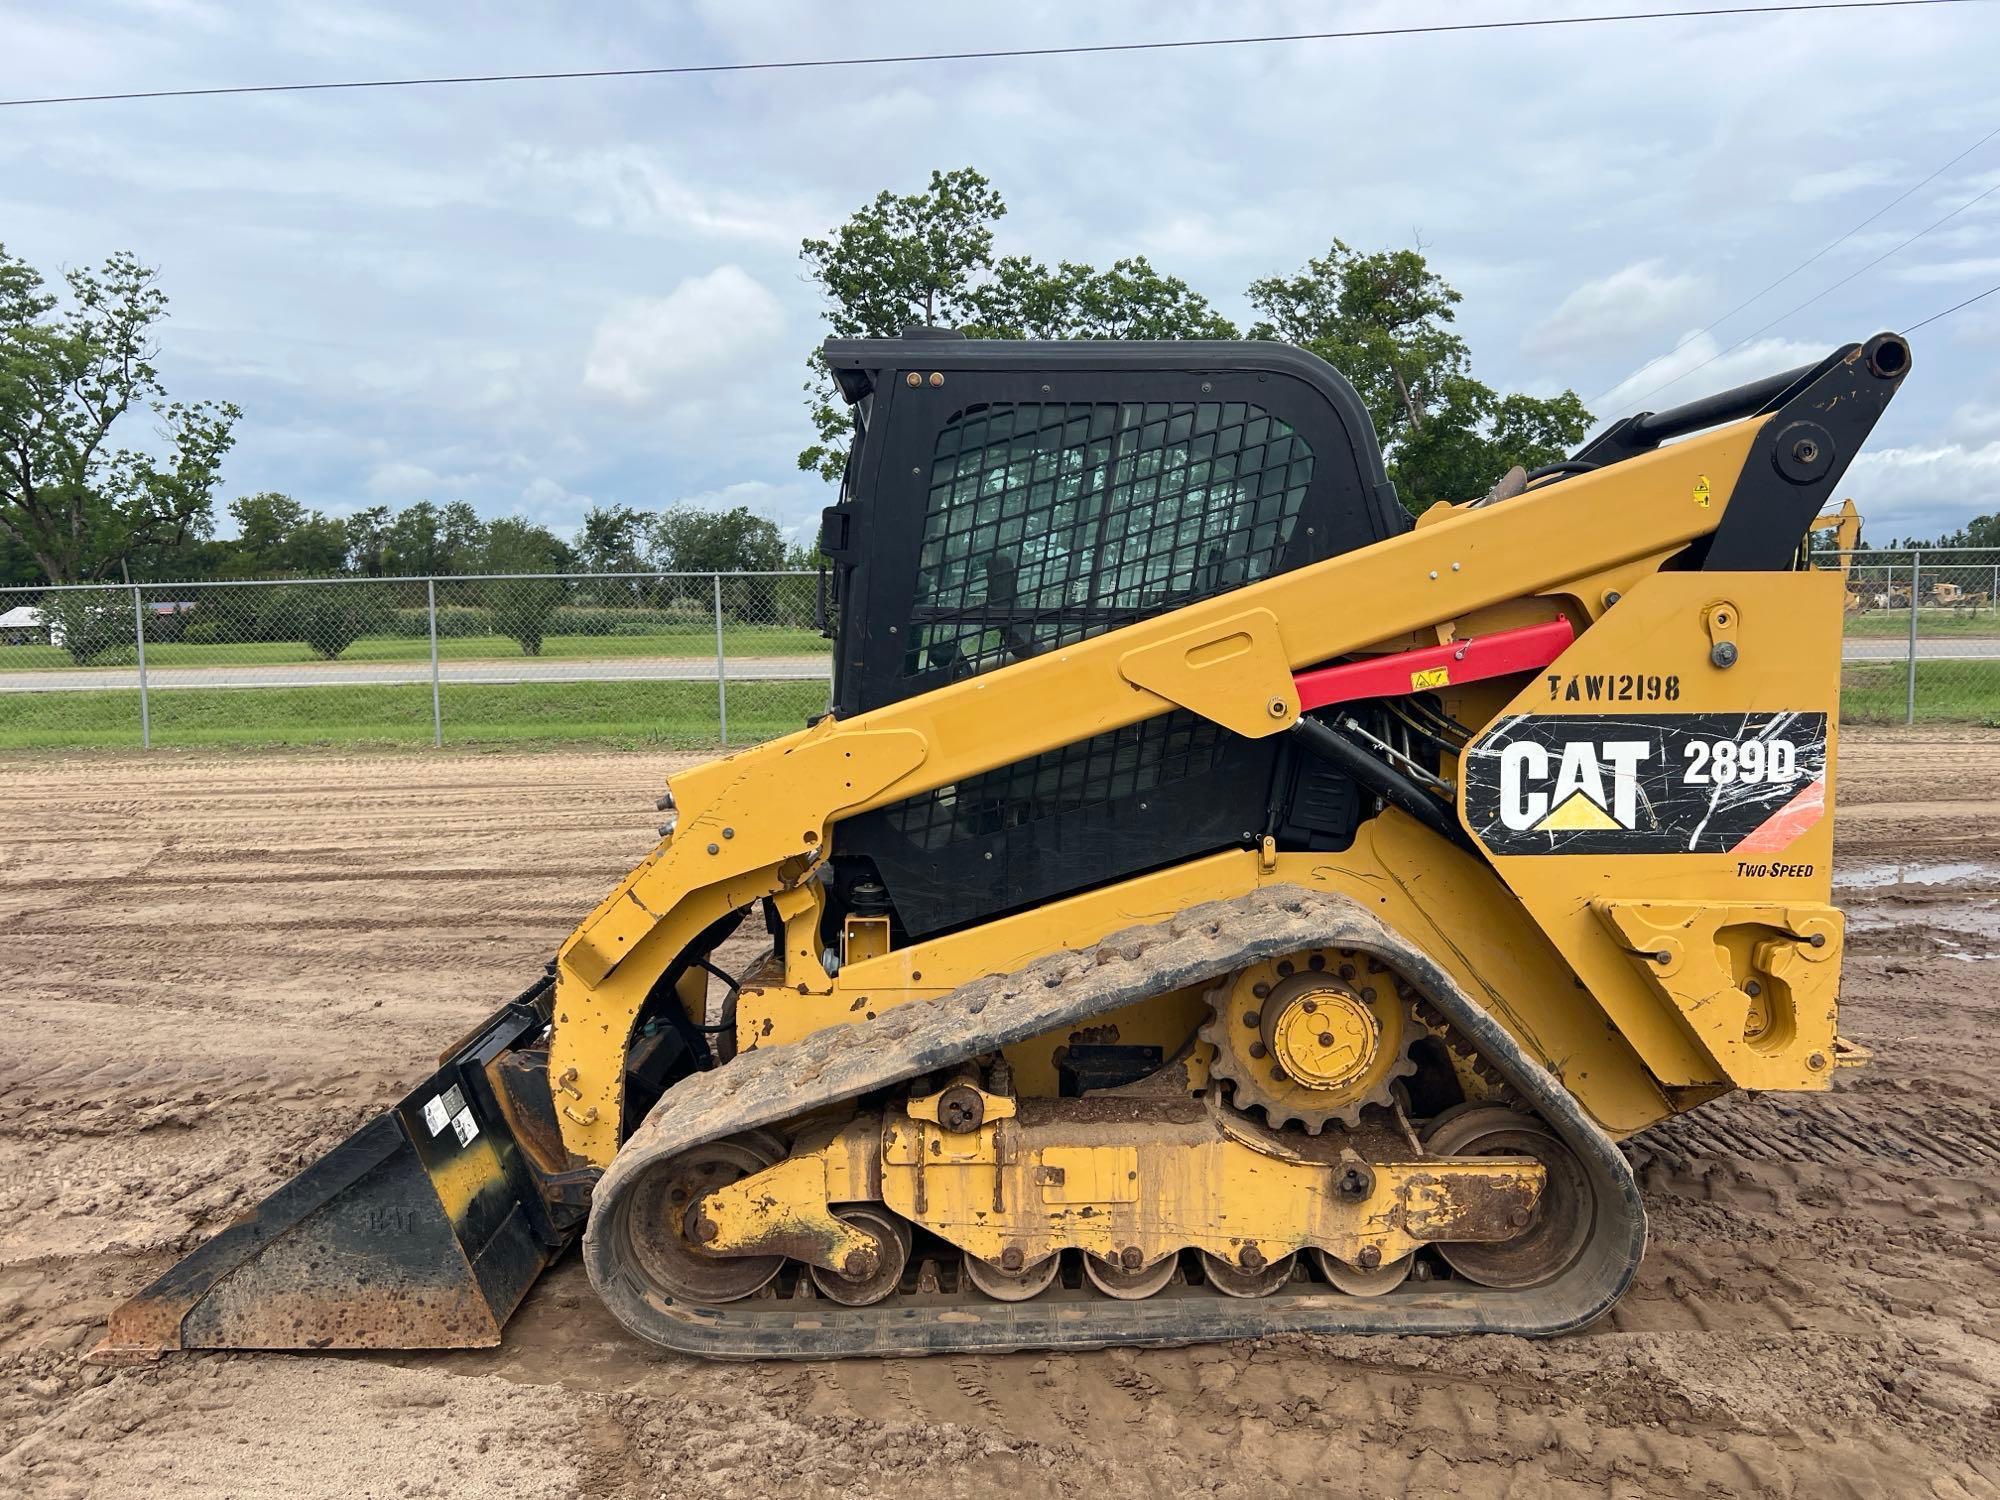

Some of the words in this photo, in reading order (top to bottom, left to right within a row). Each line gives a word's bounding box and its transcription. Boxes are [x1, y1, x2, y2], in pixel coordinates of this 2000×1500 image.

[1548, 675, 1680, 701] TAW12198
[1500, 740, 1650, 831] CAT
[1683, 739, 1797, 784] 289D
[1737, 862, 1814, 878] TWO-SPEED
